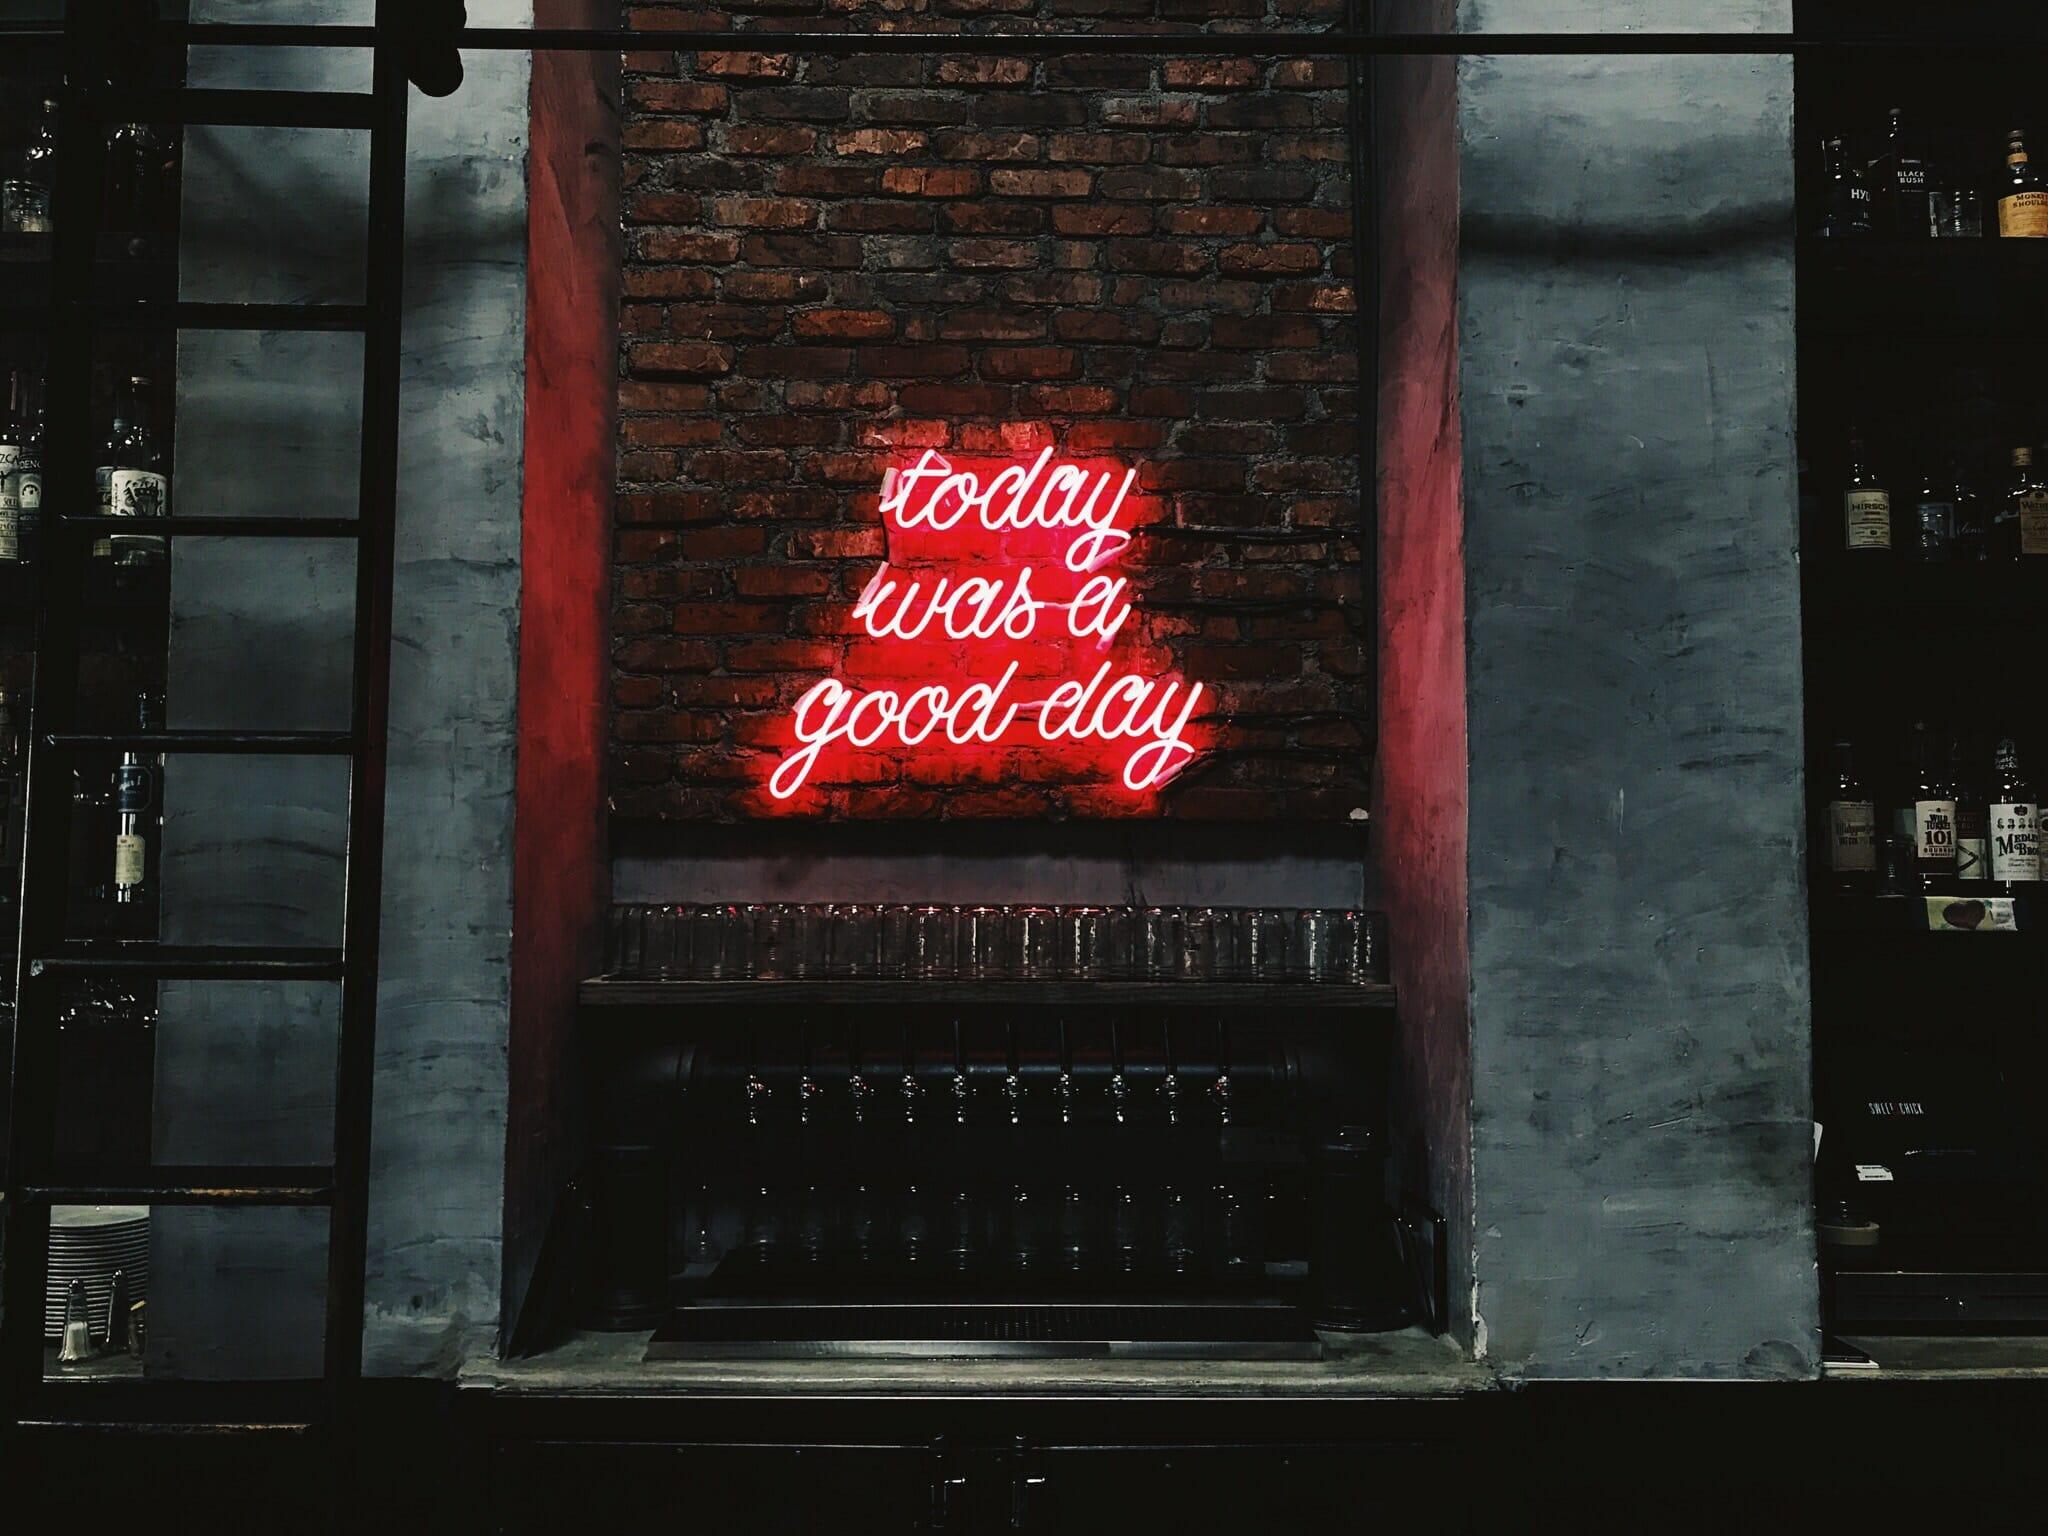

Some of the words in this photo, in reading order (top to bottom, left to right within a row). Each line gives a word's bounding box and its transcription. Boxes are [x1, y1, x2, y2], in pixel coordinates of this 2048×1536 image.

[879, 446, 1136, 572] today
[852, 567, 1044, 640] was
[1067, 575, 1131, 638] a
[769, 661, 1019, 799] good
[1037, 661, 1204, 790] day
[1925, 830, 1952, 845] 101
[1929, 814, 1948, 823] WILD
[1899, 1102, 1924, 1115] CHICK
